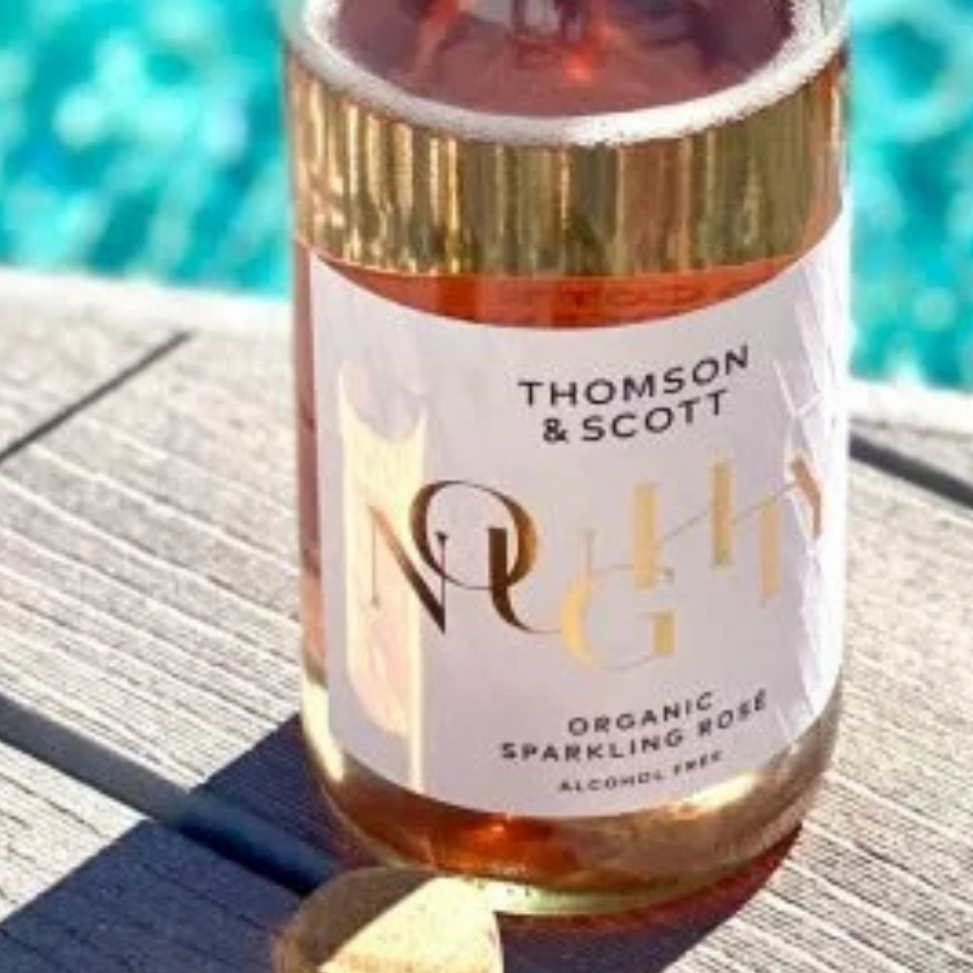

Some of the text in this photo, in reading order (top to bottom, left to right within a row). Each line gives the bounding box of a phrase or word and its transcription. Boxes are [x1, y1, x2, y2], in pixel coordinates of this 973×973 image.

[517, 344, 749, 407] THOMSON
[542, 388, 727, 444] & SCOTT
[567, 691, 713, 736] ORGANIC
[501, 728, 683, 763] SPARKLING
[558, 749, 724, 793] ALCOHOL FREE
